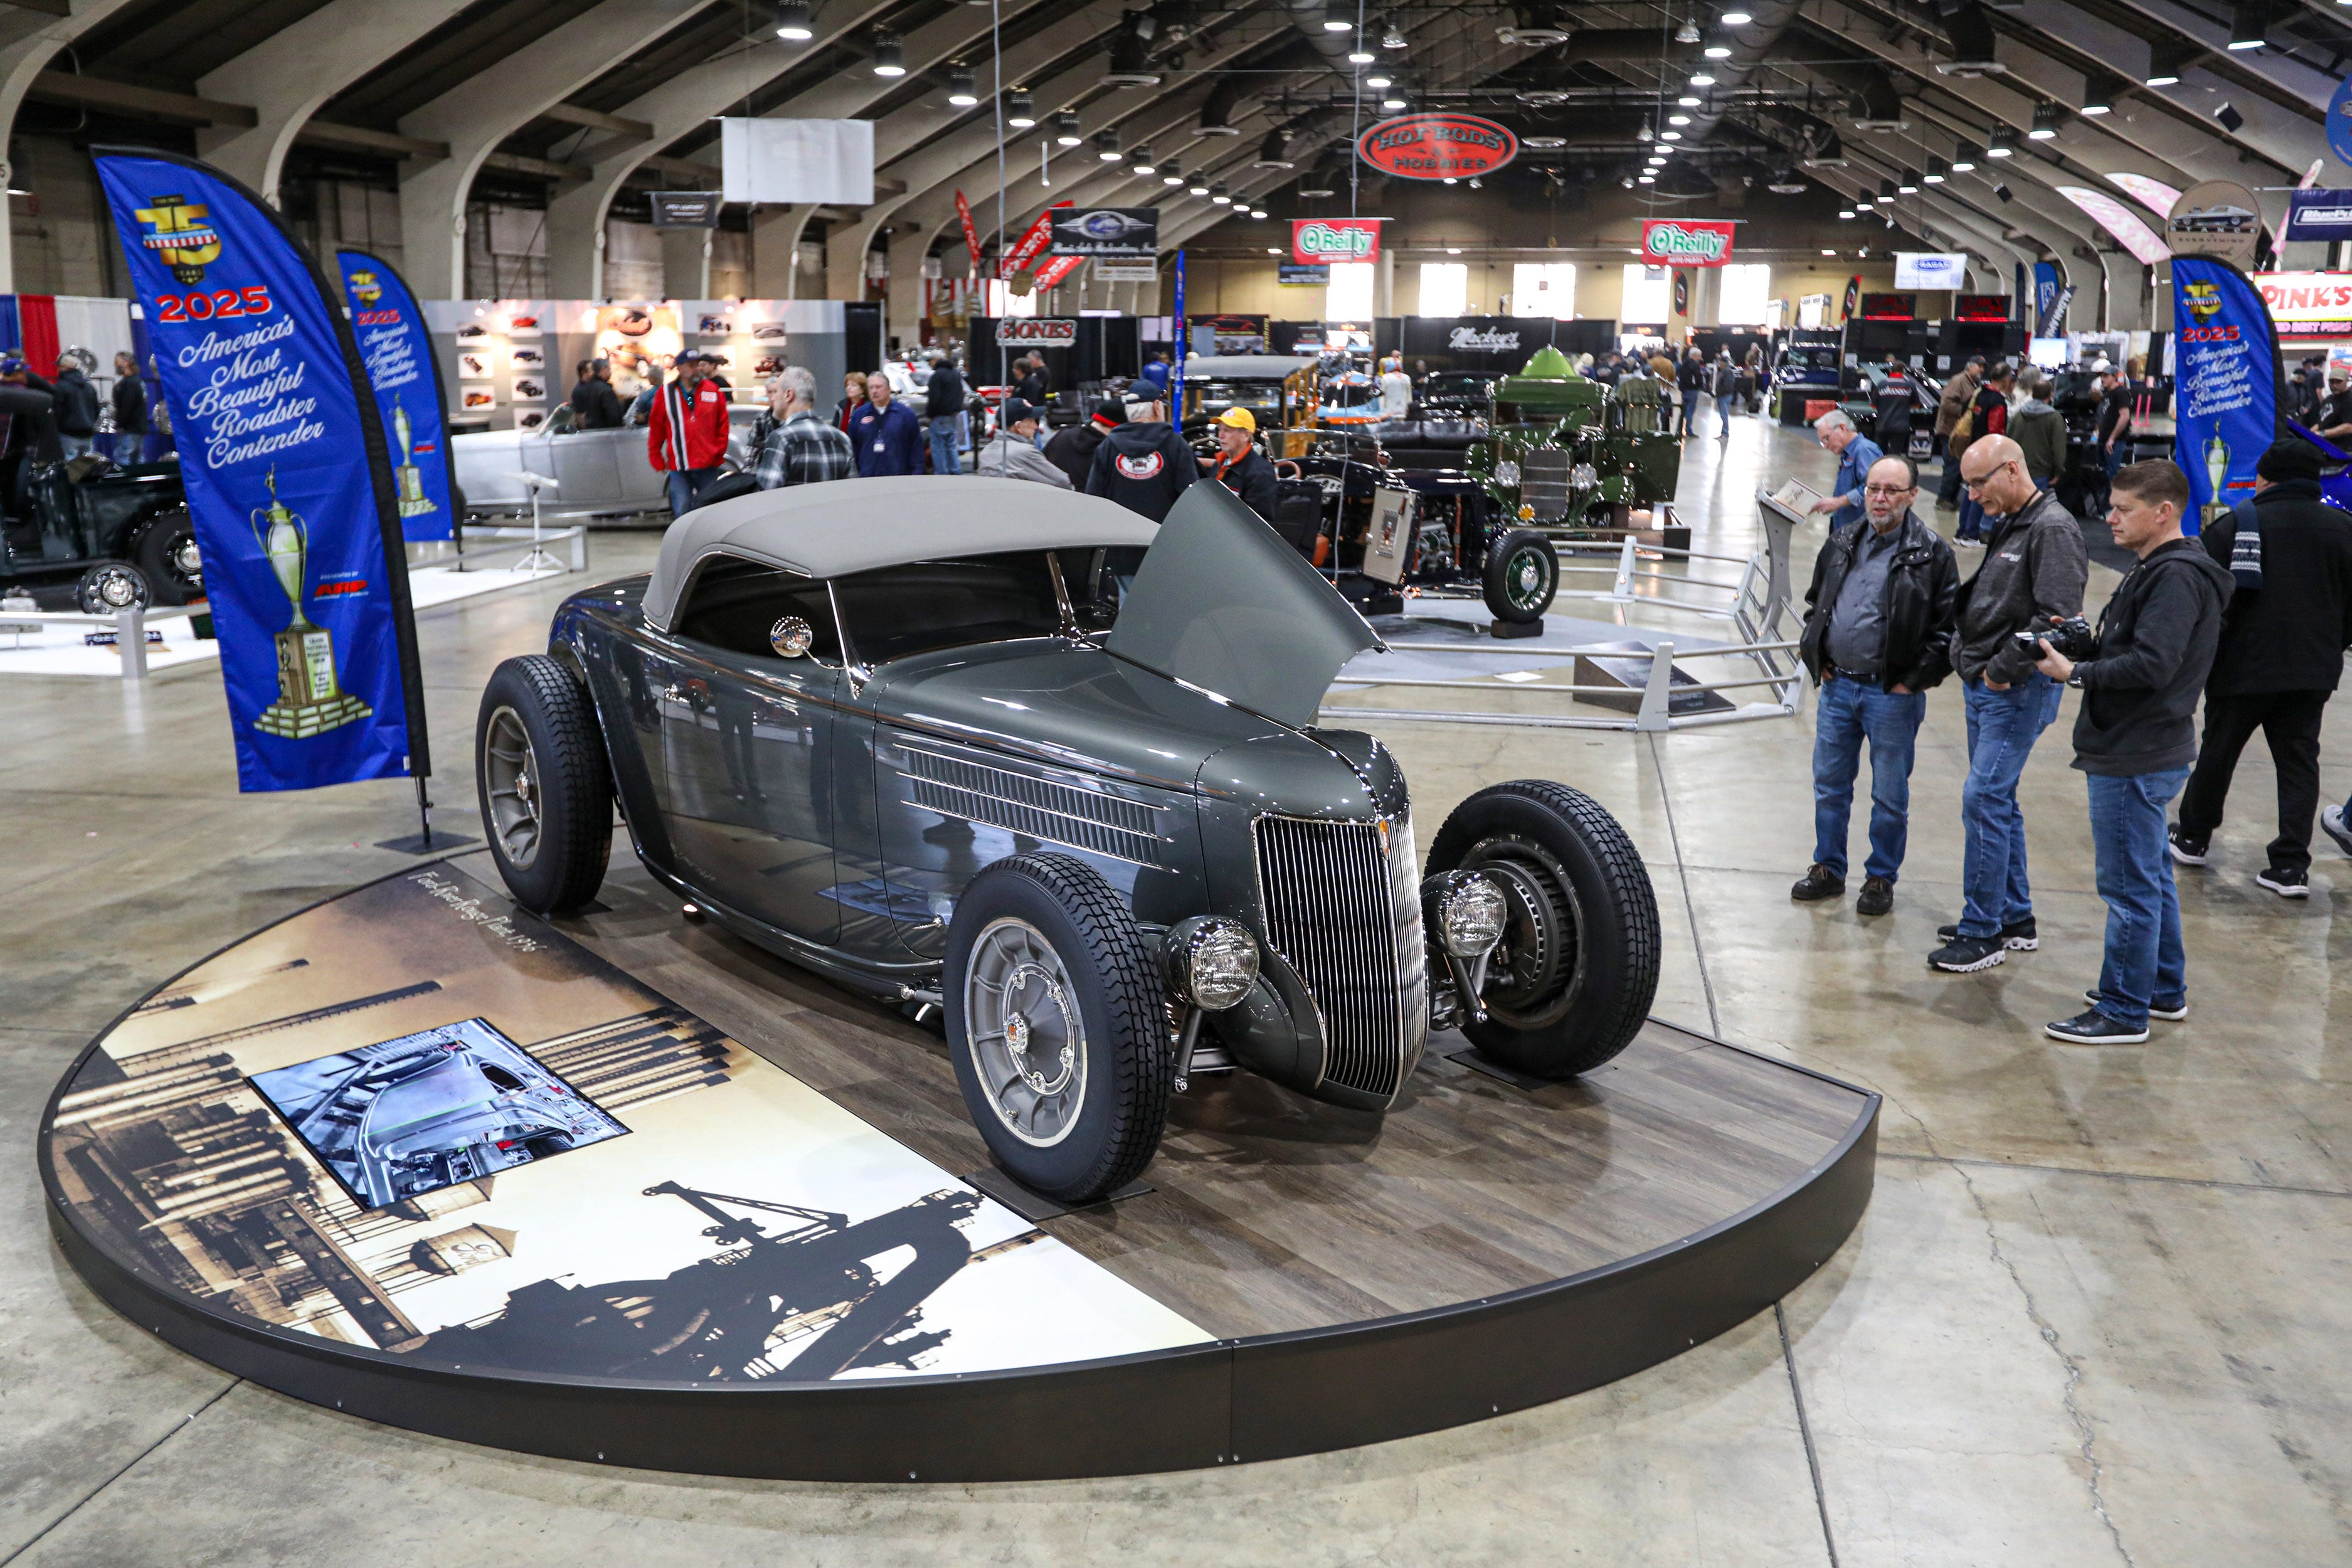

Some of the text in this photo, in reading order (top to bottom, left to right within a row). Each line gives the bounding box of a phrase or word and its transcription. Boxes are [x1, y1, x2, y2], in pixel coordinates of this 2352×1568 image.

[1378, 127, 1500, 150] HOT RODS
[1394, 156, 1487, 168] HOBBIES
[1298, 224, 1375, 256] O'Reilly
[1648, 224, 1728, 260] O'Reilly
[156, 285, 273, 323] 2025
[2262, 285, 2351, 309] PINK'S
[357, 309, 401, 326] 2025
[2183, 325, 2240, 343] 2025
[178, 314, 295, 368] America's
[210, 347, 281, 388] Most
[186, 361, 305, 420] Beautiful
[204, 398, 317, 444] Roadster
[207, 418, 326, 469] Contender
[314, 580, 368, 596] ARP
